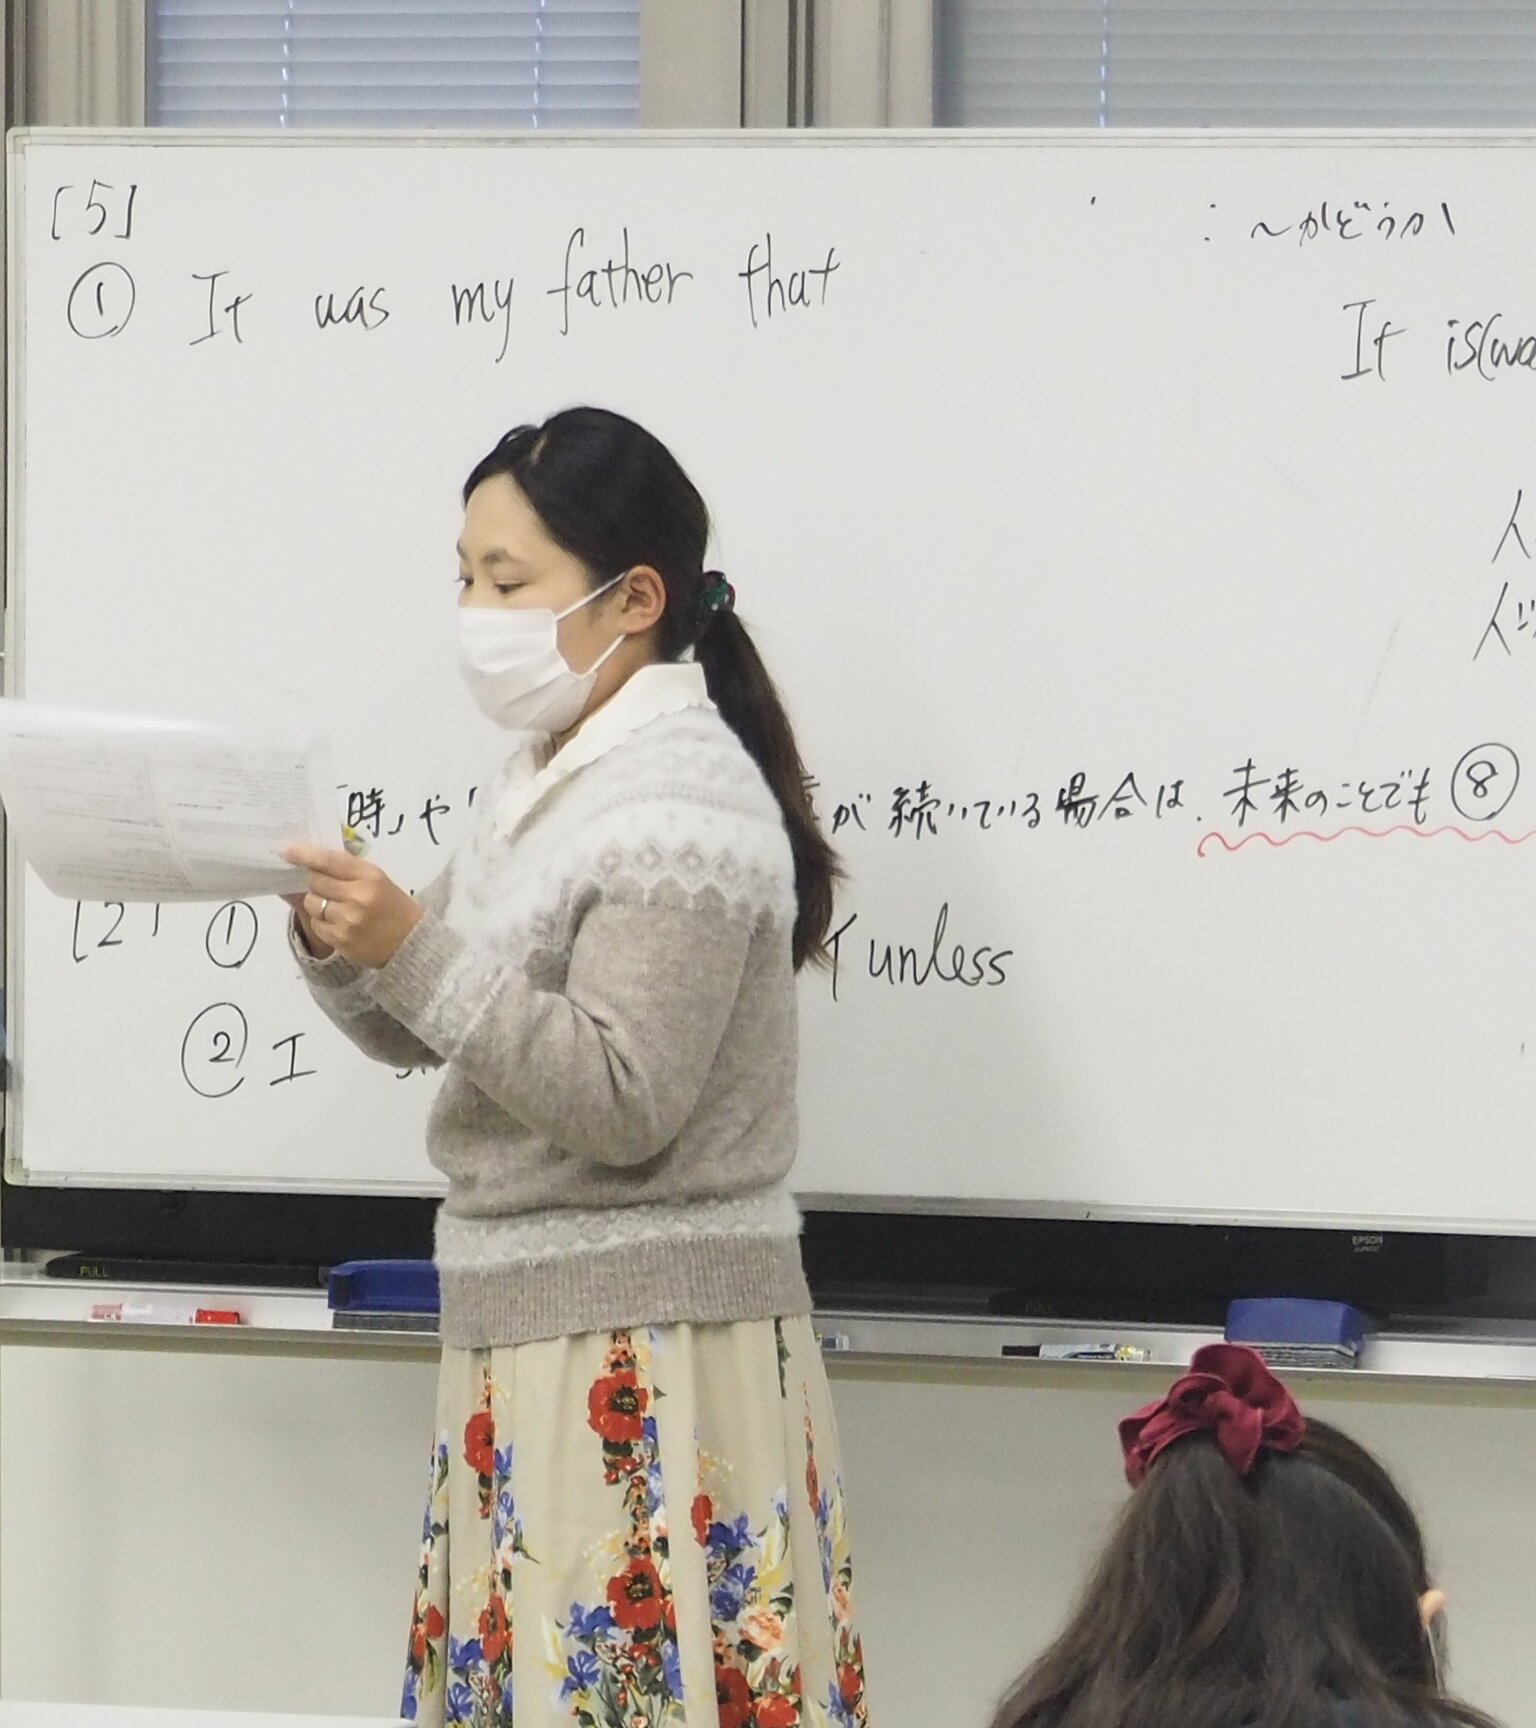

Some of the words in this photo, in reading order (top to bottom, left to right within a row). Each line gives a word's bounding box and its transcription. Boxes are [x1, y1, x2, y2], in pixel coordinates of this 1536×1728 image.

[189, 270, 253, 346] It
[451, 277, 515, 363] my
[546, 226, 694, 337] father
[738, 232, 841, 330] that
[1340, 298, 1408, 382] It
[868, 902, 1014, 987] unless
